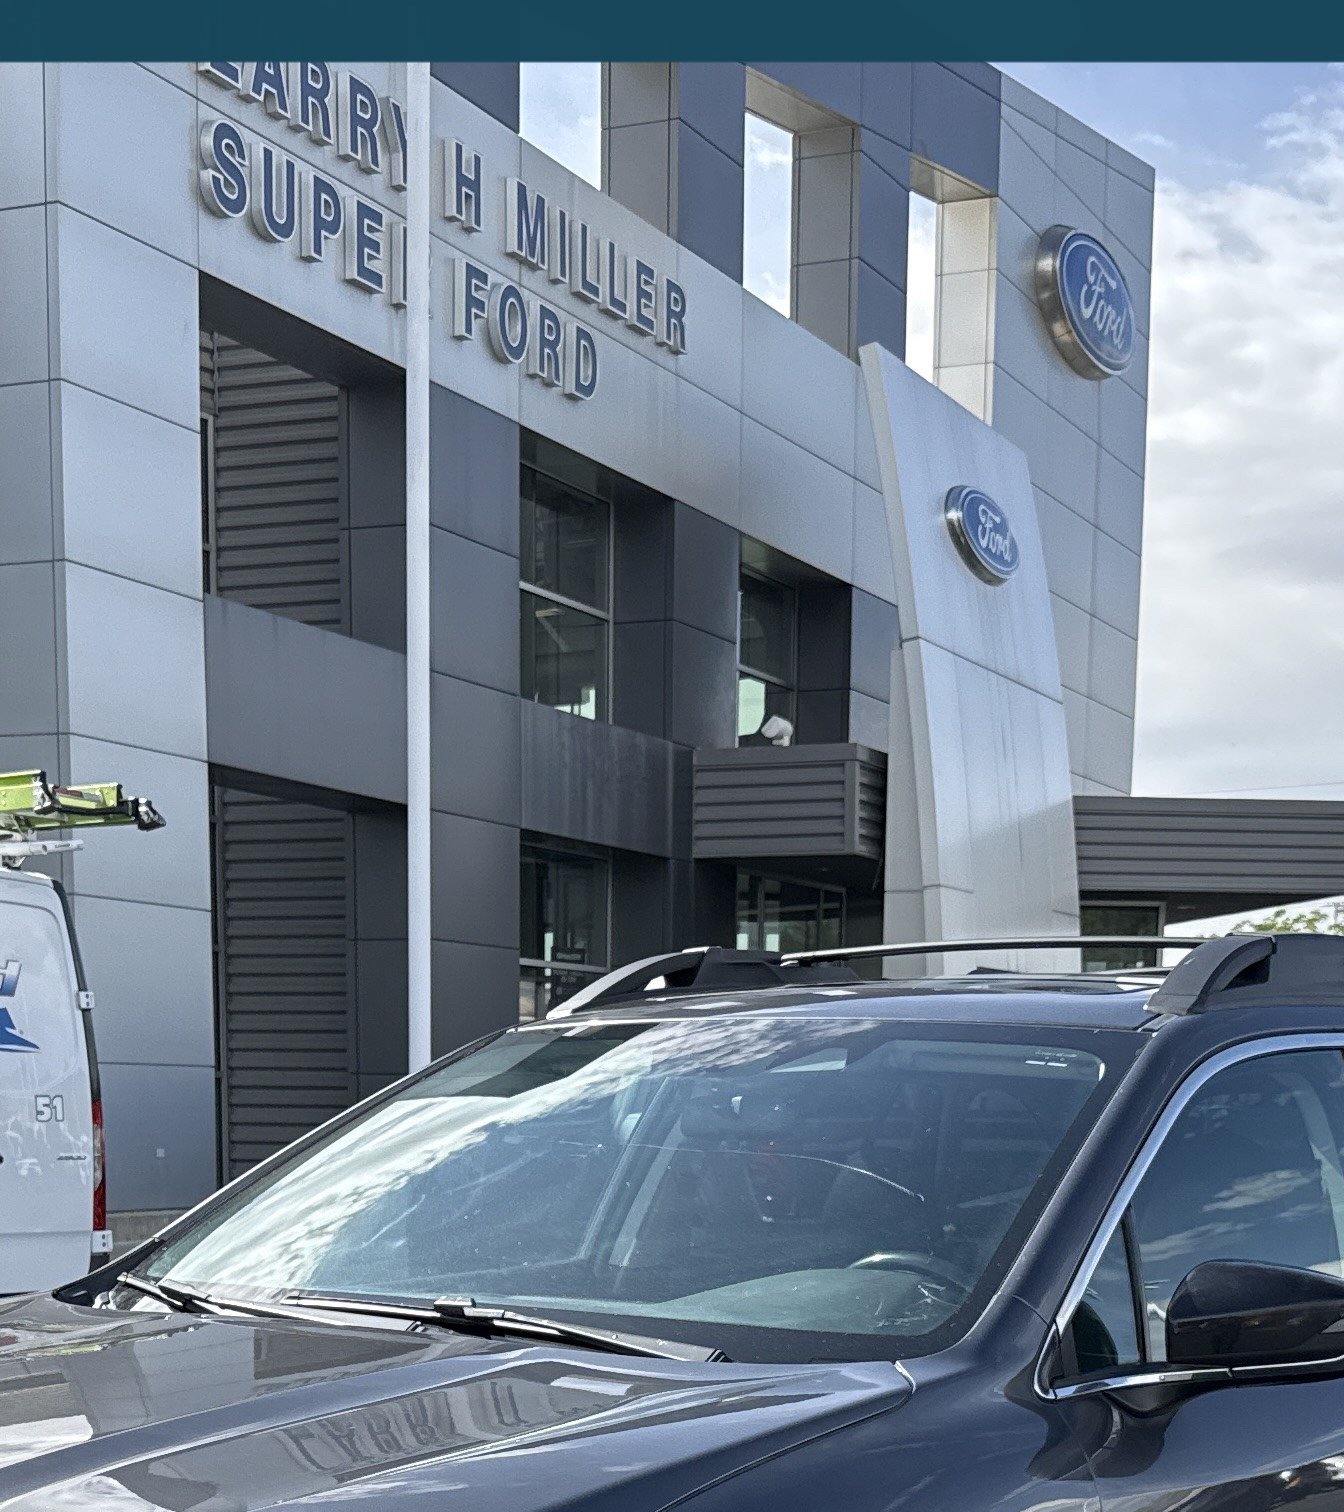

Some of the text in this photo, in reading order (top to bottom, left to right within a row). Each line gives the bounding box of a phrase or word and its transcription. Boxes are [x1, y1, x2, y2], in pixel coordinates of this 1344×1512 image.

[199, 62, 688, 355] ARRY H MILLER
[199, 118, 598, 401] SUPE FORD
[1080, 255, 1125, 352] Ford
[978, 504, 1012, 563] Ford
[35, 1095, 65, 1123] 51
